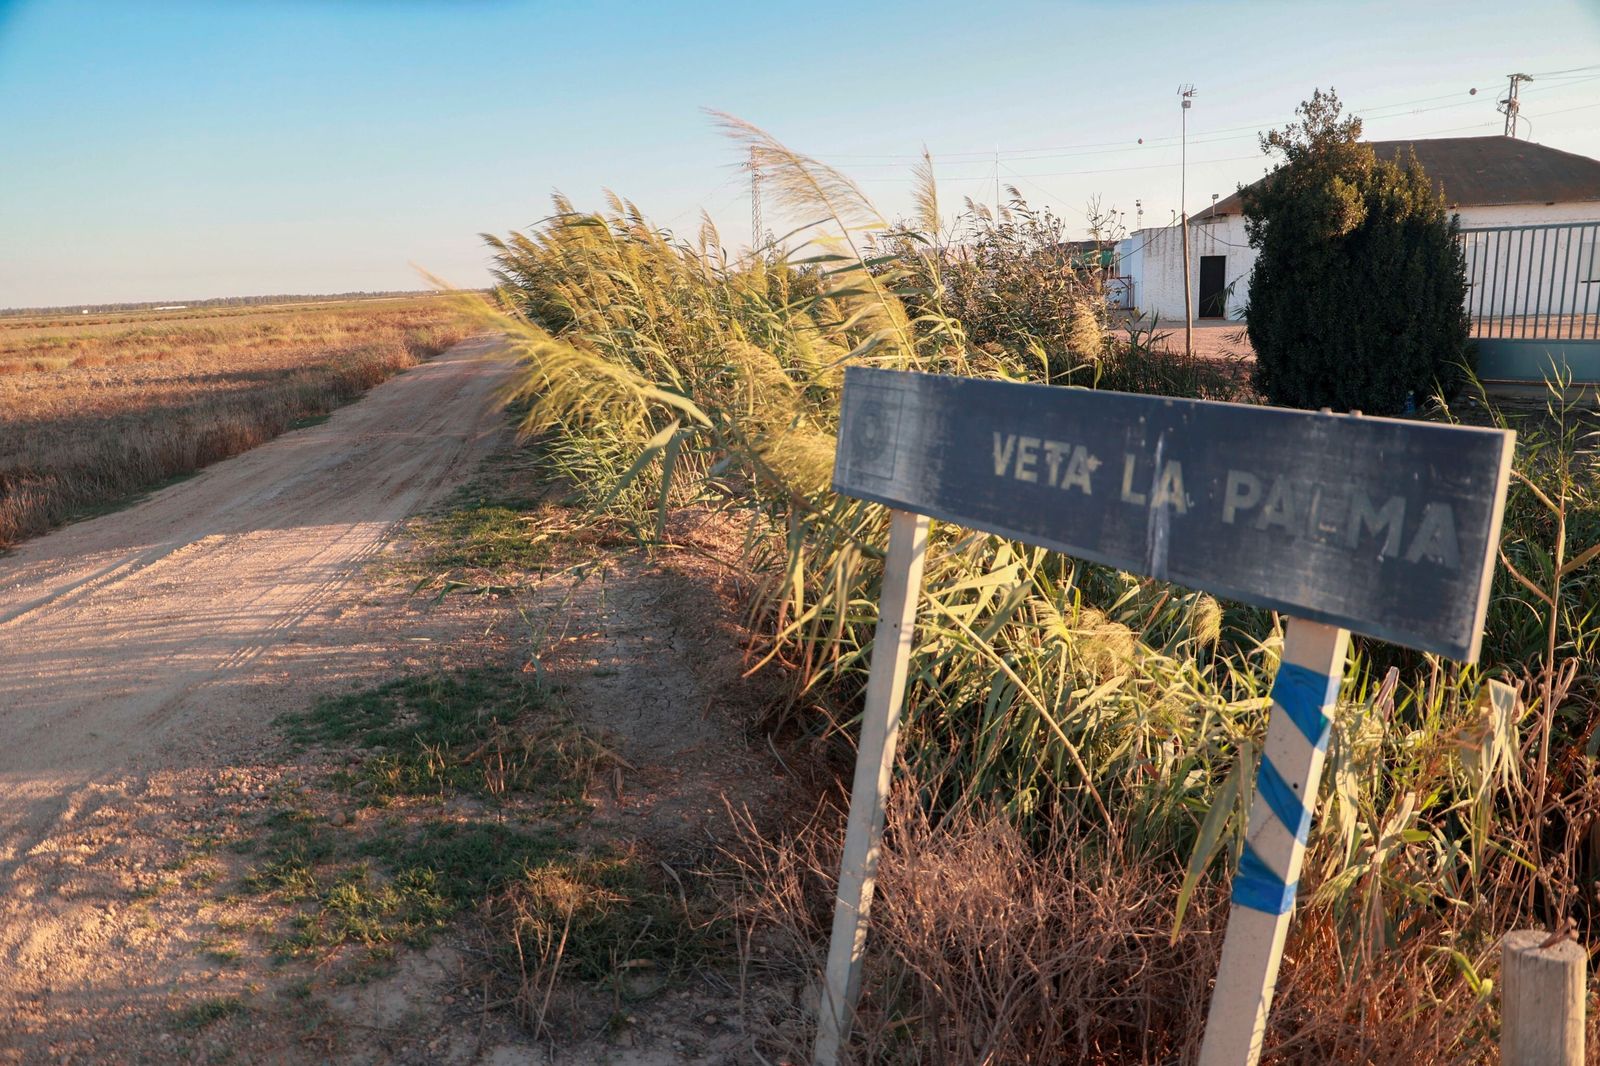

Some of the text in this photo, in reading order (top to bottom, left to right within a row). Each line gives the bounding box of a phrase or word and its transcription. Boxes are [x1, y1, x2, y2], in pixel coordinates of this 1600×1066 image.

[992, 431, 1460, 570] VETA LA PALMA
